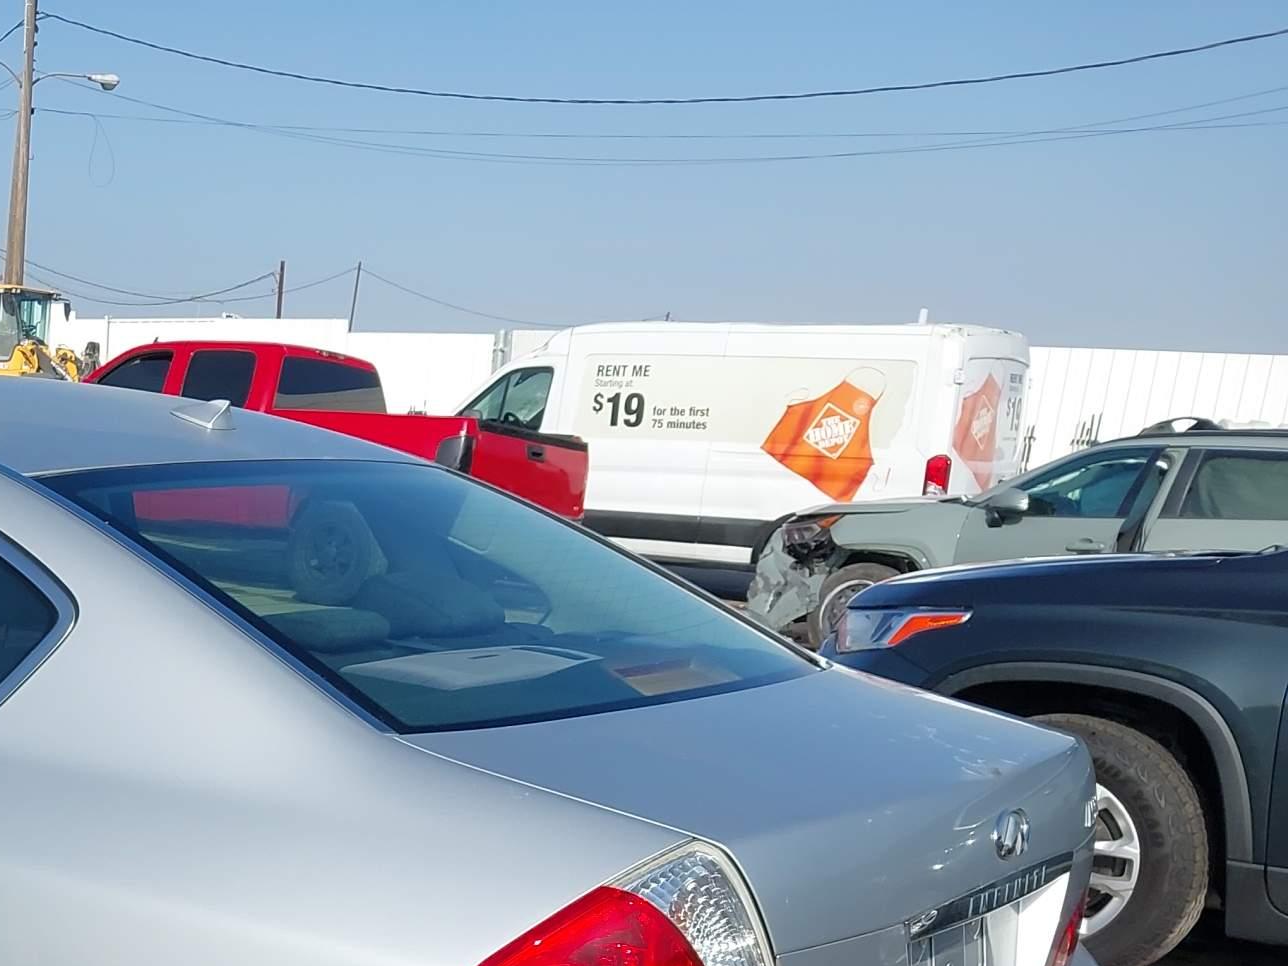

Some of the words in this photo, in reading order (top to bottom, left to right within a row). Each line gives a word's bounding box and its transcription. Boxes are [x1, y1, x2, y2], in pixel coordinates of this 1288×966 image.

[597, 365, 629, 377] RENT
[631, 365, 651, 377] ME
[594, 379, 624, 389] Starting
[624, 379, 633, 388] at
[592, 392, 645, 427] $19
[653, 406, 667, 417] for
[670, 406, 686, 417] the
[688, 406, 710, 417] first
[651, 419, 664, 429] 75
[666, 419, 708, 430] minutes
[821, 415, 840, 427] THE
[808, 420, 856, 441] HOME
[818, 434, 849, 448] DEPOT
[968, 865, 1047, 918] INFINITI
